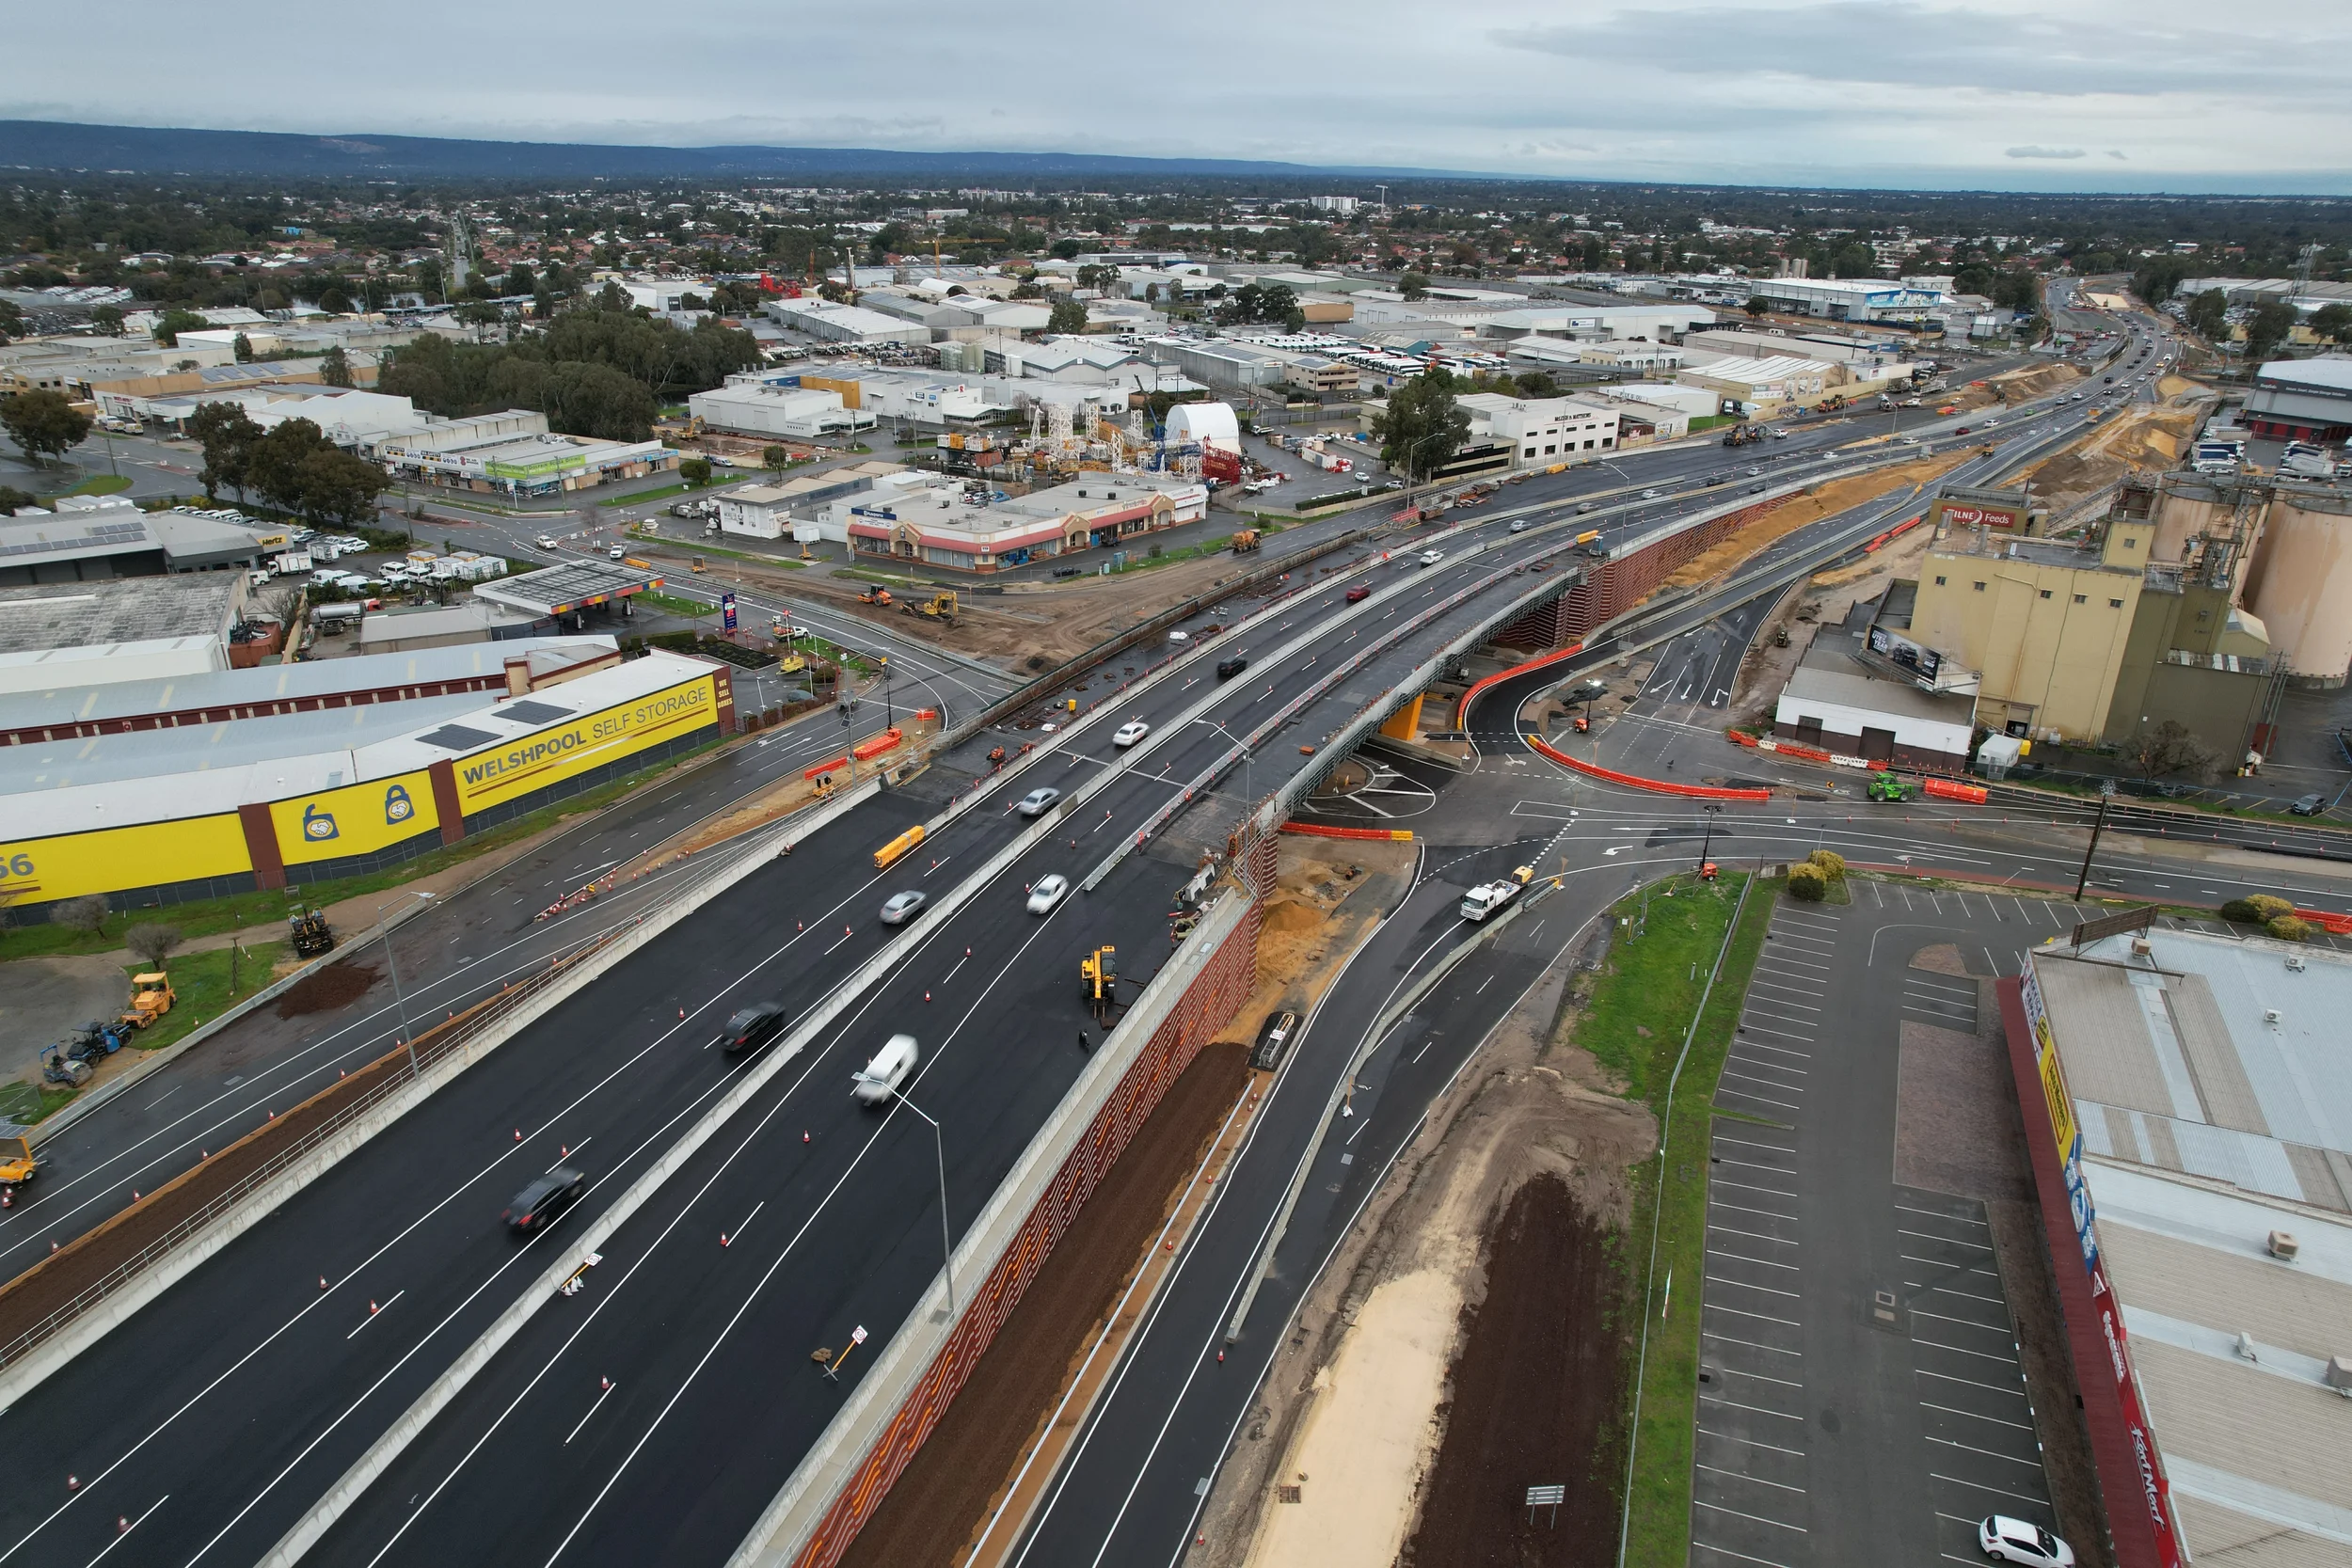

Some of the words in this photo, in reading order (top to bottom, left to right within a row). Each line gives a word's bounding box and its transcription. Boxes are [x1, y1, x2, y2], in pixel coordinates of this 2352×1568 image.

[1984, 513, 2010, 524] Feeds
[262, 536, 282, 546] Hertz
[718, 678, 727, 688] WE
[718, 689, 730, 698] SELL
[717, 697, 733, 708] BOXES
[463, 731, 587, 784] WELSHPOOL
[593, 712, 630, 739] SELF
[636, 686, 707, 724] STORAGE
